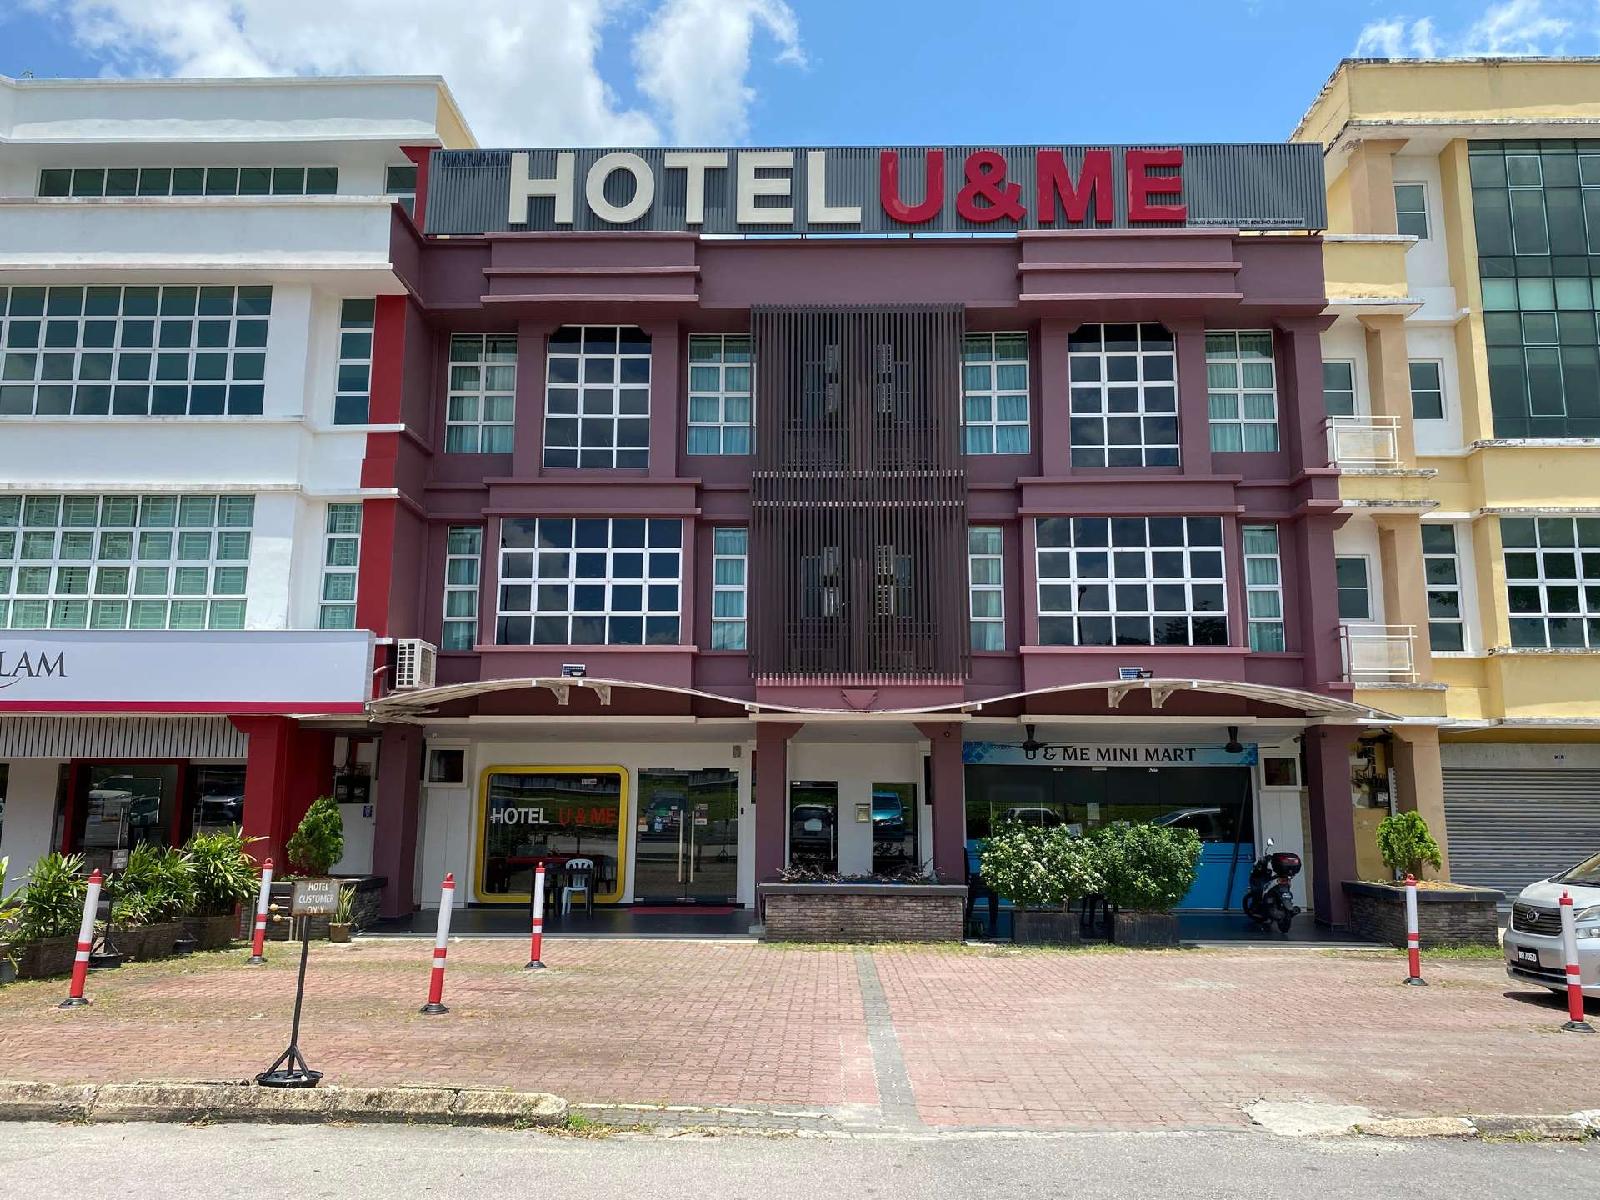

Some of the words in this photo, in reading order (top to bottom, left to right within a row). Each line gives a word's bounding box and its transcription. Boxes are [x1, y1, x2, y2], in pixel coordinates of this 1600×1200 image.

[508, 151, 862, 225] HOTEL
[879, 148, 1188, 225] U&ME
[1025, 748, 1037, 760] U
[1043, 748, 1056, 760] &
[1062, 748, 1090, 761] ME
[1096, 748, 1139, 762] MINI
[1144, 748, 1197, 762] MART
[491, 807, 549, 825] HOTEL
[560, 808, 573, 826] U
[576, 807, 586, 825] &
[590, 807, 618, 827] ME
[308, 883, 329, 891] HOTEL
[298, 894, 334, 904] CUSTOMER
